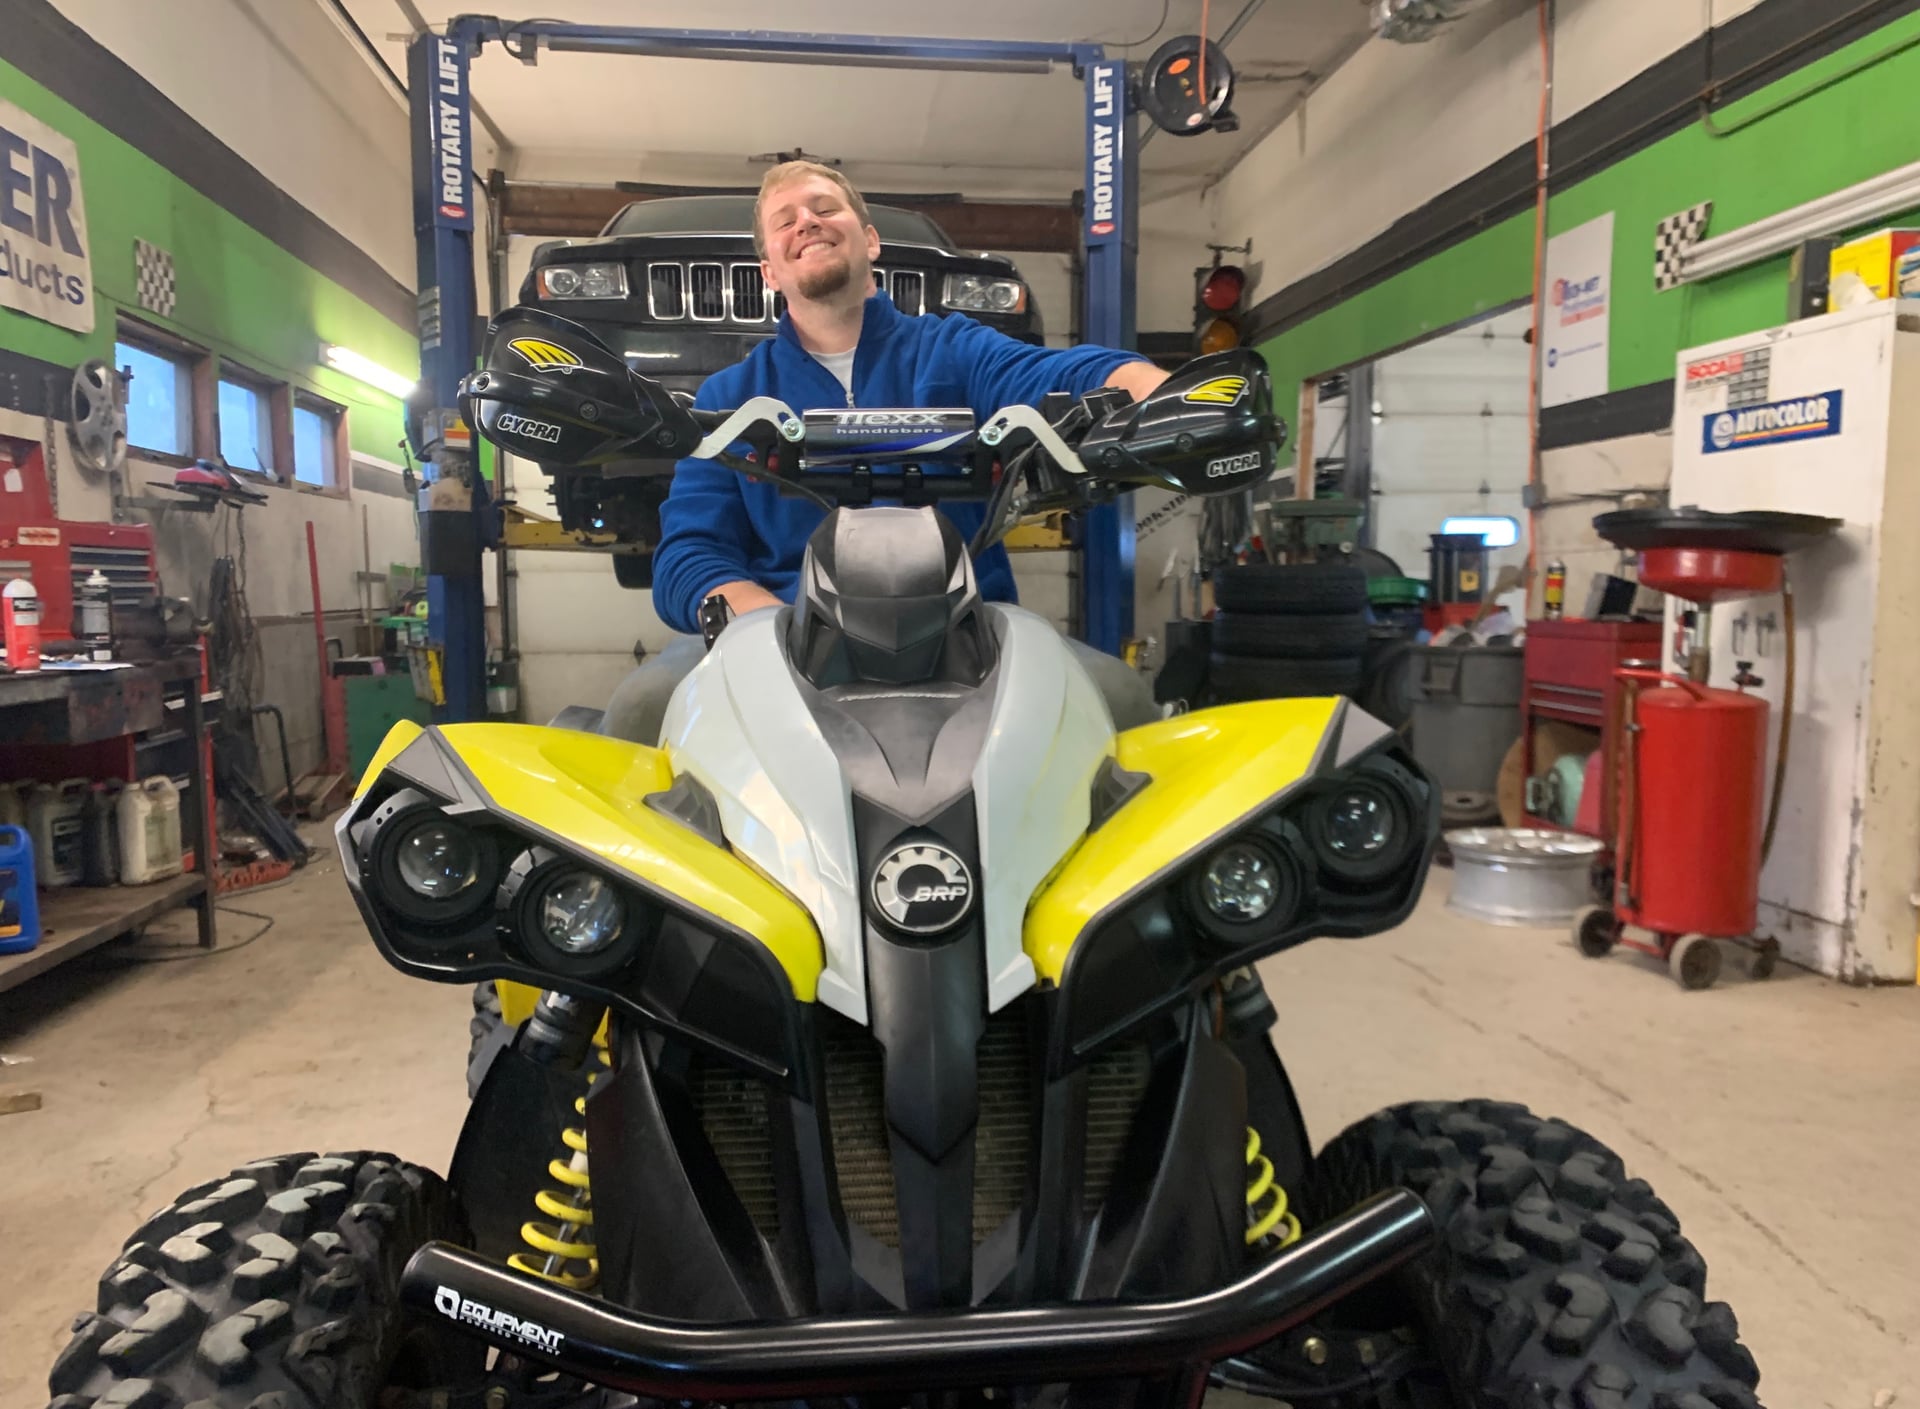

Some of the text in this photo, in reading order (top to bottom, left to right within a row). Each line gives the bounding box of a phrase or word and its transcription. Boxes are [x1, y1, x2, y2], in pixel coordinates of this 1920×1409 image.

[438, 39, 459, 95] LIFT
[1093, 66, 1113, 117] LIFT
[440, 100, 463, 204] ROTARY
[1093, 123, 1113, 221] ROTARY
[497, 413, 561, 443] CYCRA
[836, 427, 943, 435] handlebars
[1736, 397, 1829, 433] AUTOCOLOR
[1207, 451, 1261, 478] CYCRA
[913, 886, 967, 902] BRP
[460, 1299, 564, 1348] EQUIPMENT
